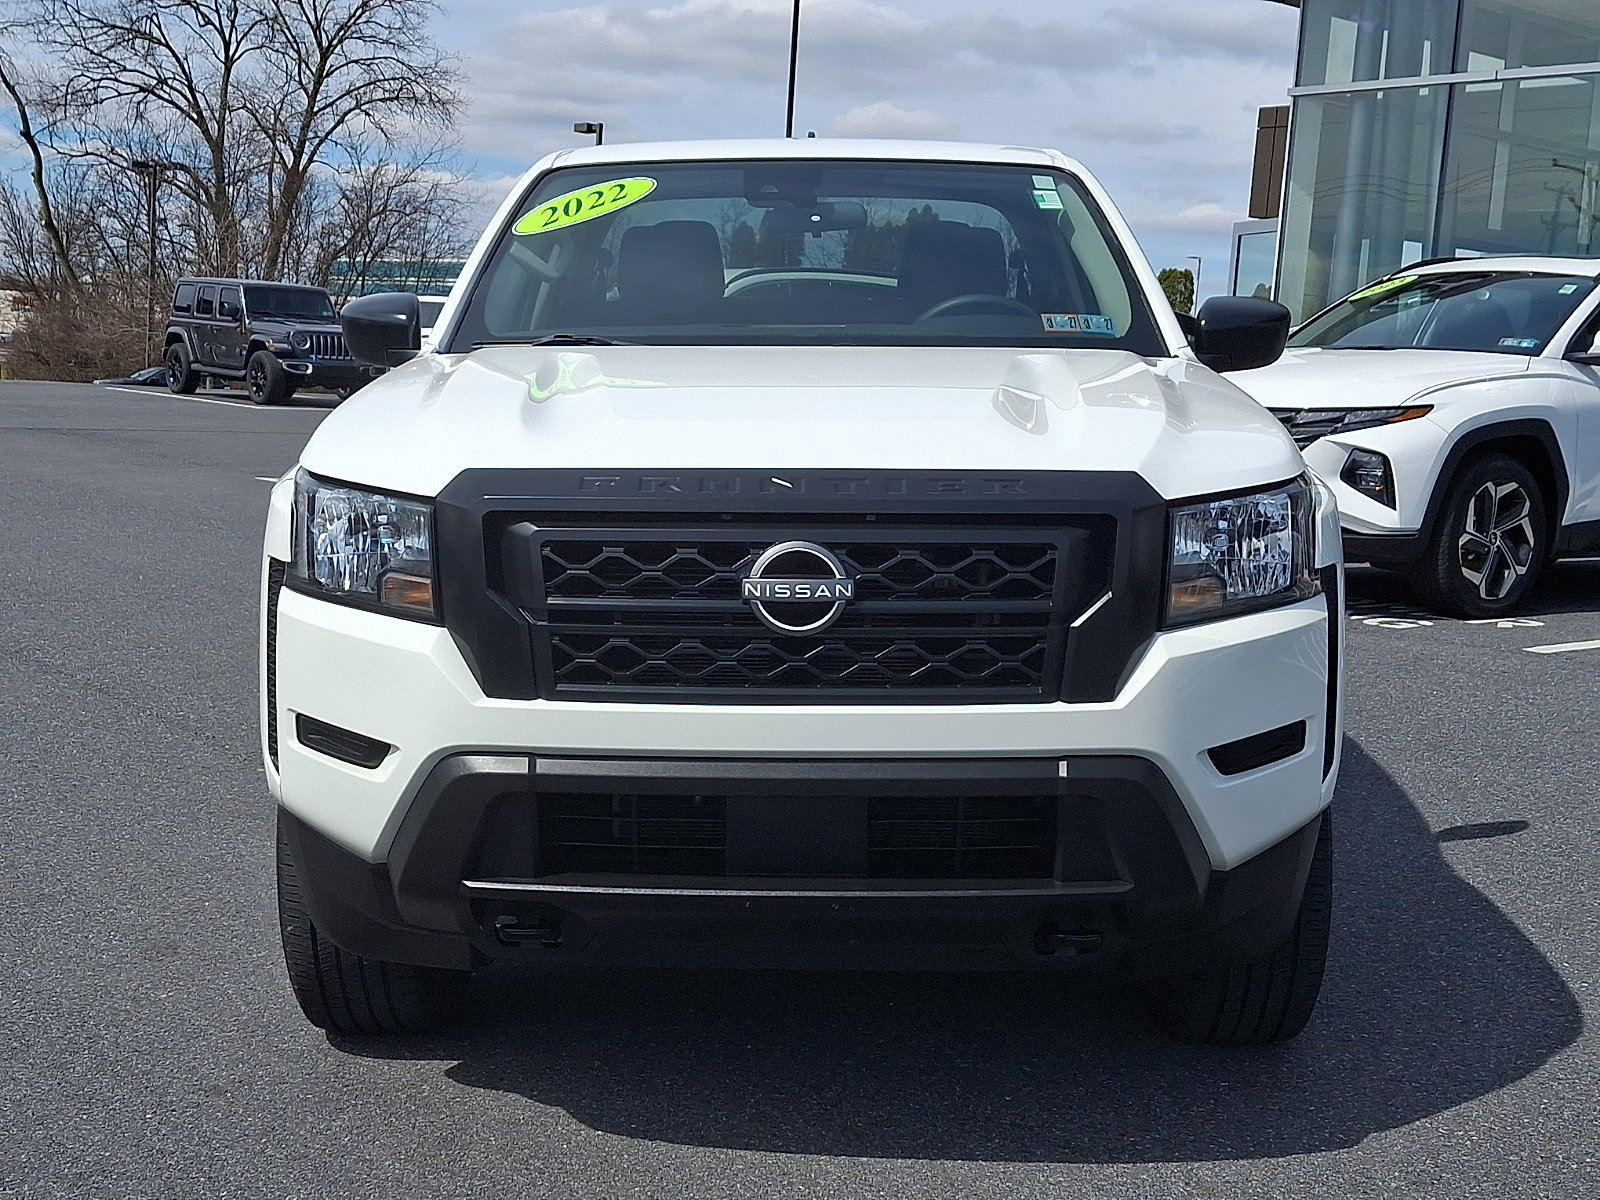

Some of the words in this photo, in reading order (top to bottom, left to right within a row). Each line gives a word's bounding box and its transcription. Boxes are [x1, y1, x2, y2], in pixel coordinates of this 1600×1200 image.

[540, 183, 628, 227] 2022
[578, 475, 1029, 495] FRONTIER
[744, 582, 852, 598] NISSAN
